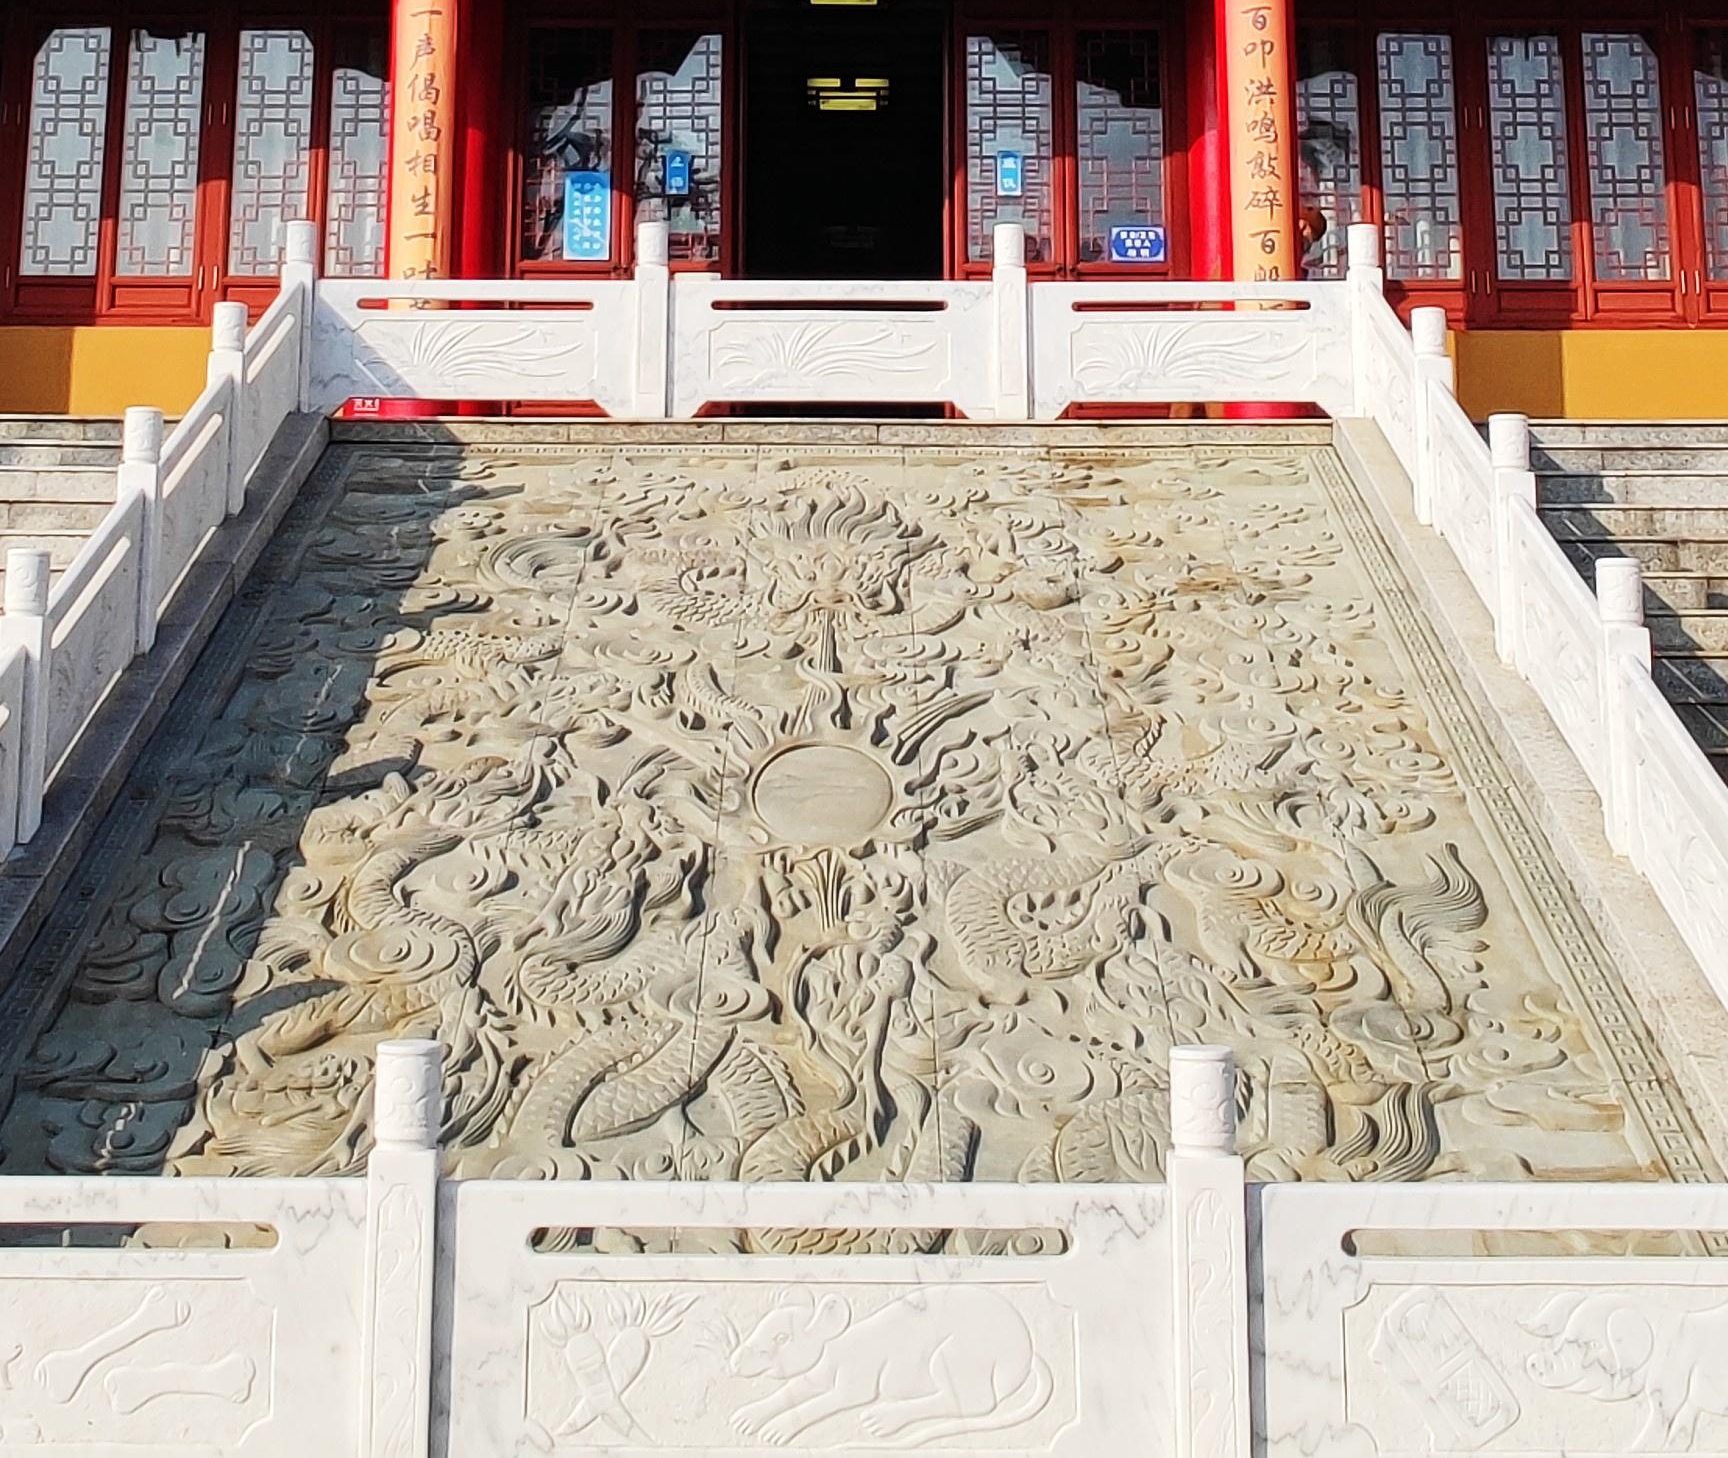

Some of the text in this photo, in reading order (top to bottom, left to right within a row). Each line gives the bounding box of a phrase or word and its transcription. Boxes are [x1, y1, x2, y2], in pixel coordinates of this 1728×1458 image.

[1240, 5, 1284, 310] 百叩洪鸣敲碎百般
